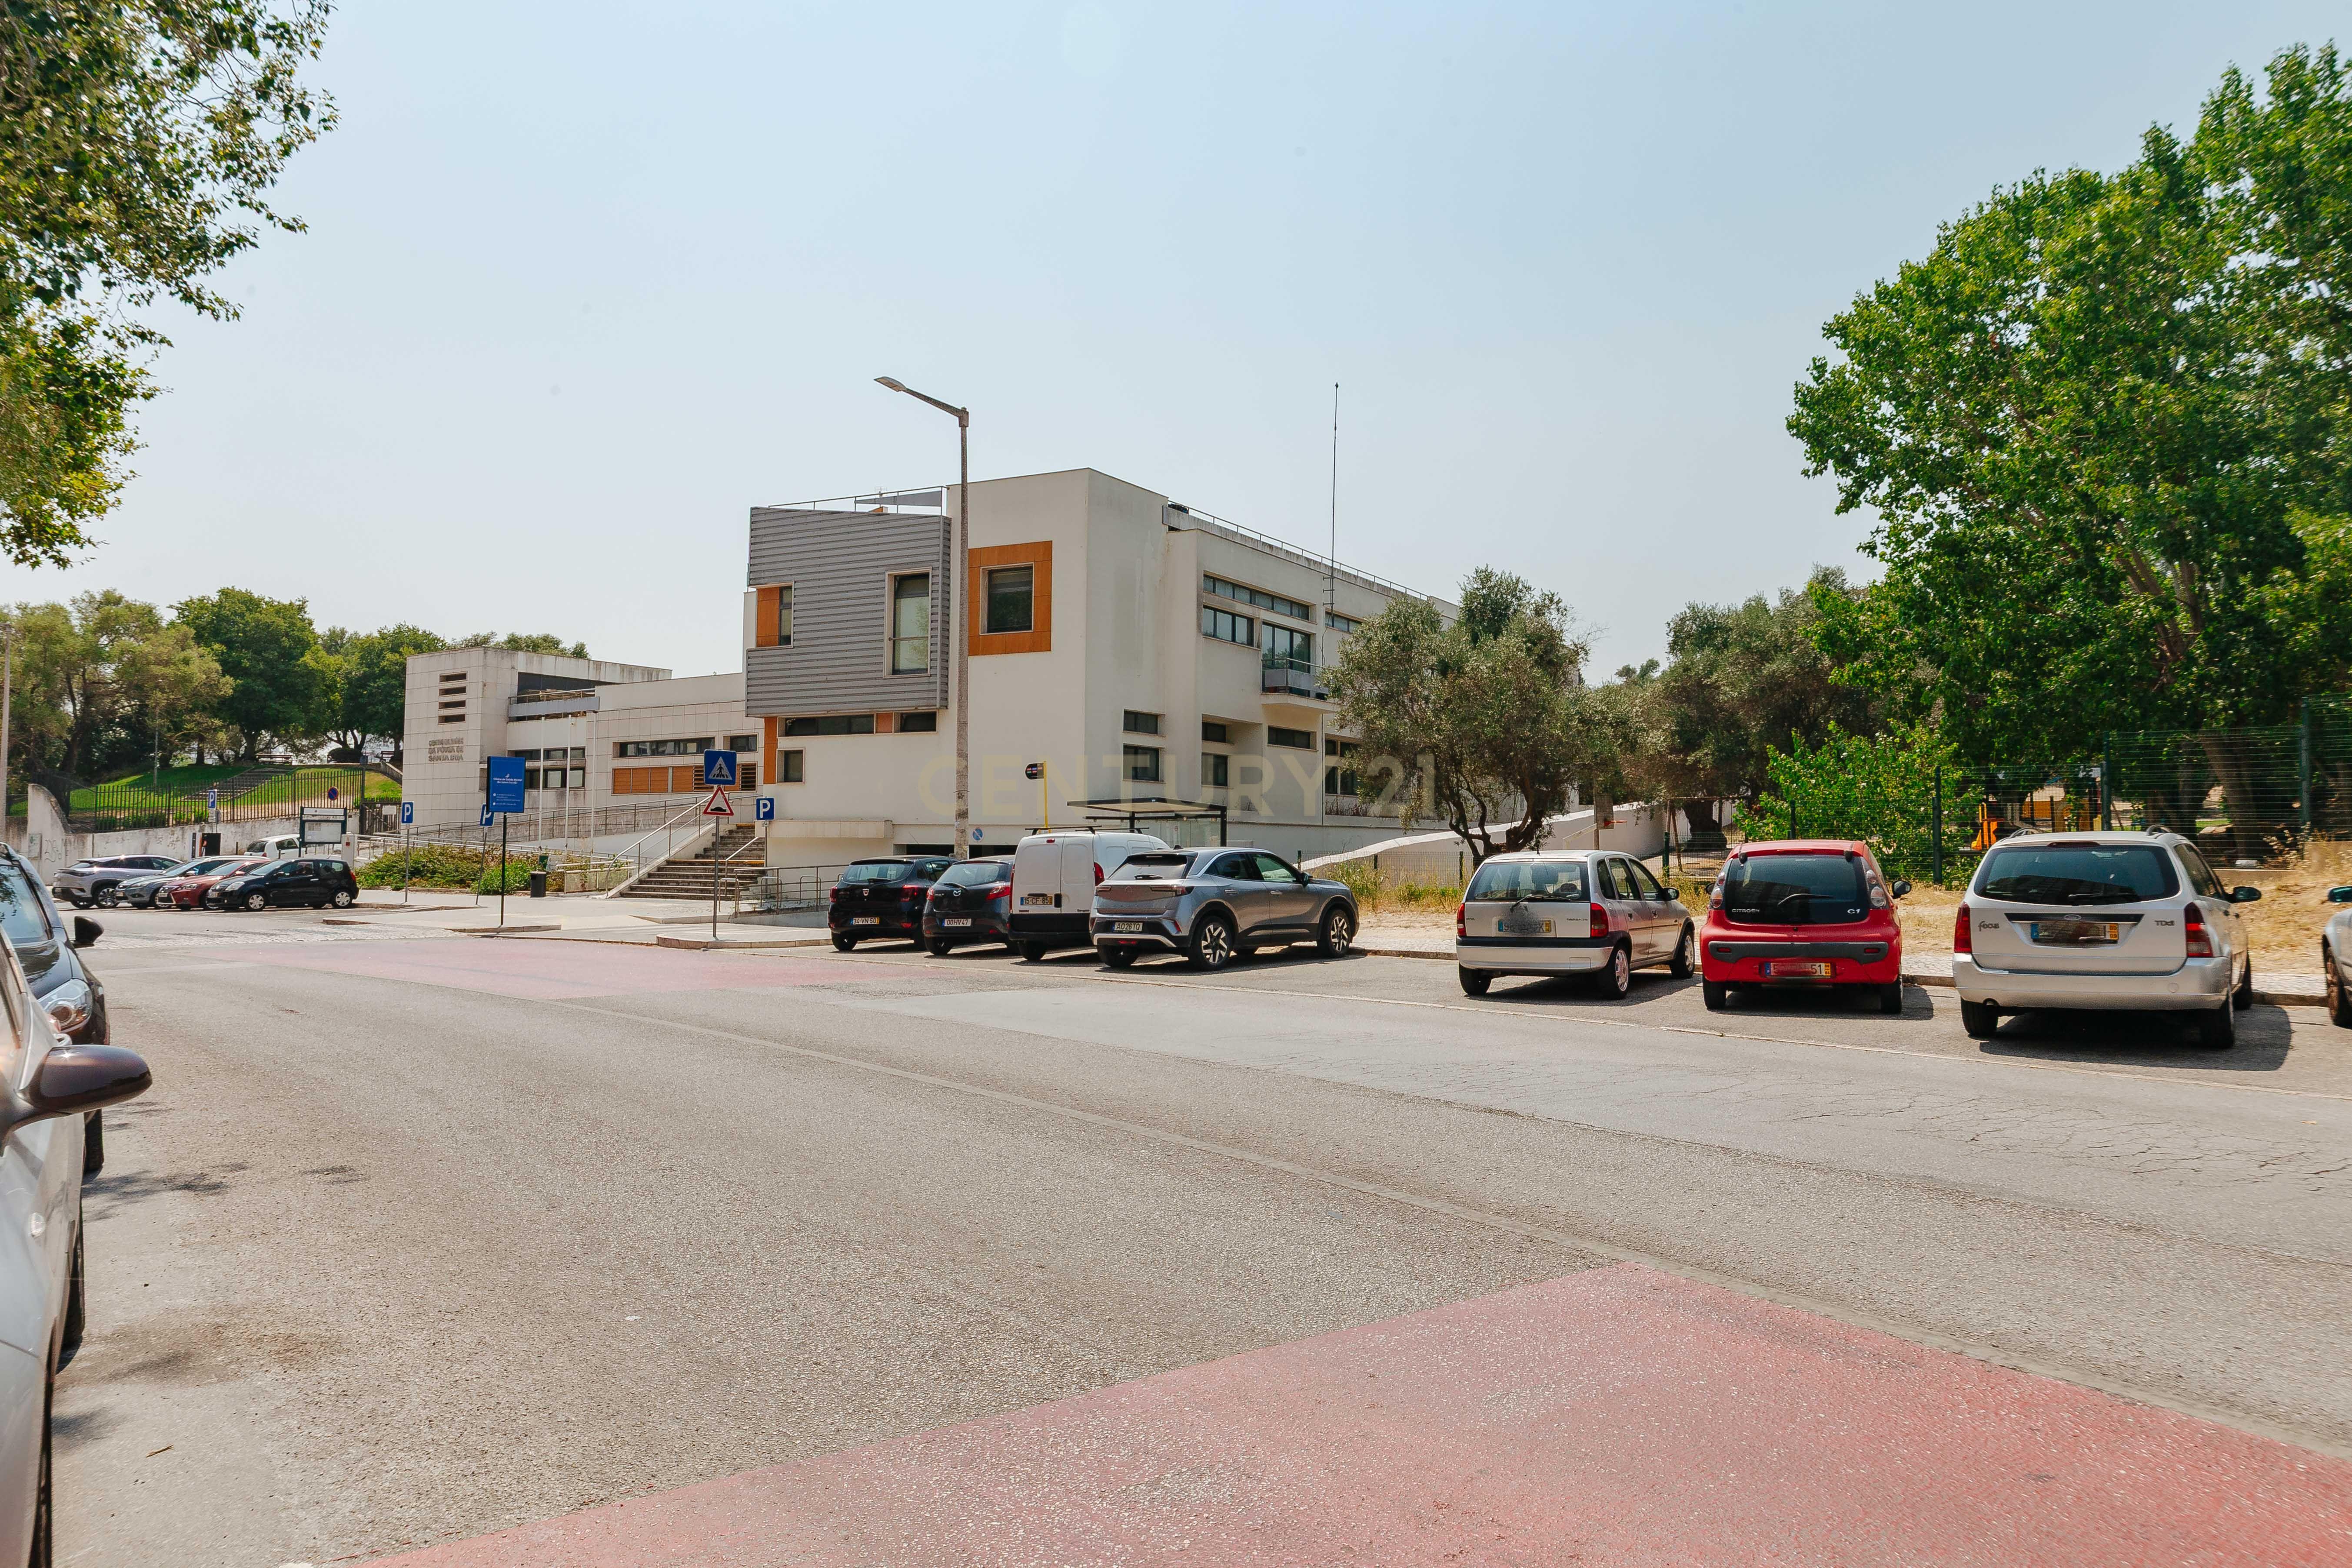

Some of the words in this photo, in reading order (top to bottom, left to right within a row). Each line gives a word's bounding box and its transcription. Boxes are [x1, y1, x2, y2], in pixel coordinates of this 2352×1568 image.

[209, 792, 214, 807] P
[404, 804, 411, 822] P
[760, 800, 770, 818] P
